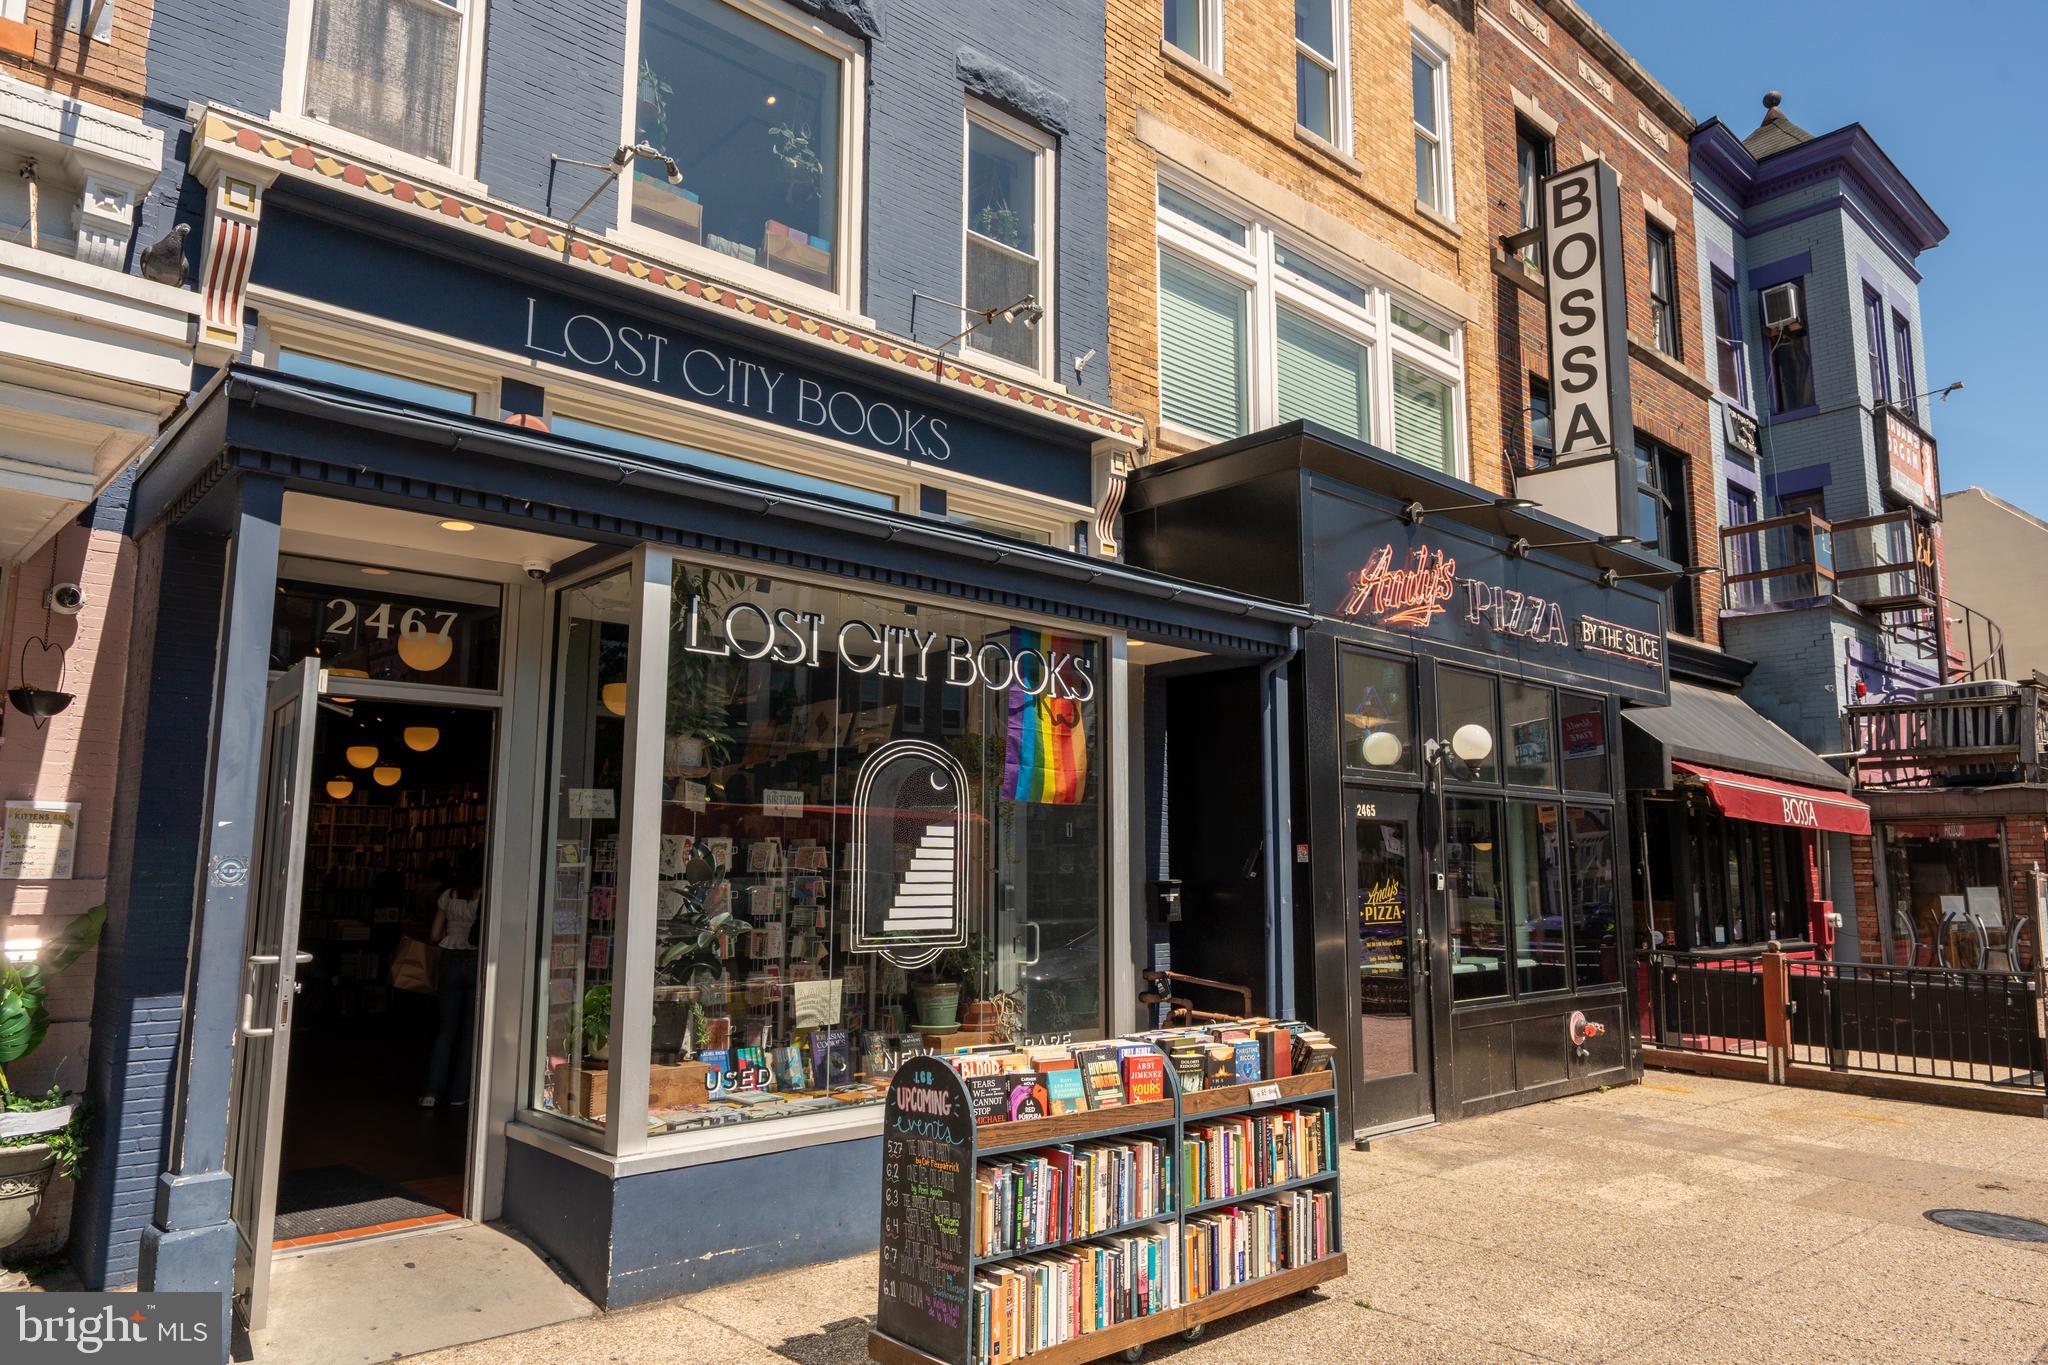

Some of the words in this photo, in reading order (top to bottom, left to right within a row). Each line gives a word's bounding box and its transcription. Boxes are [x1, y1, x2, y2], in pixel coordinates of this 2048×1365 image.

[1551, 175, 1608, 454] BOSSA
[524, 297, 668, 383] LOST
[682, 348, 785, 414] CITY
[796, 377, 951, 461] BOOKS
[1349, 543, 1456, 627] Andy's
[1468, 578, 1569, 646] PIZZA
[1581, 621, 1597, 643] BY
[1598, 626, 1623, 650] THE
[1625, 632, 1659, 660] SLICE
[325, 597, 459, 644] 2467
[683, 593, 825, 668] LOST
[837, 618, 937, 682] CITY
[944, 633, 1096, 702] BOOKS
[766, 794, 801, 806] BIRTHDAY
[1356, 804, 1376, 817] 2465
[1782, 797, 1818, 827] BOSSA
[1368, 878, 1399, 906] Andy's
[1365, 905, 1402, 921] PIZZA
[1235, 1047, 1260, 1056] CHRISTINE
[1239, 1055, 1257, 1063] RICCIO
[961, 1059, 1001, 1079] BLOOD
[1088, 1060, 1118, 1076] HIVEMIND
[1136, 1062, 1155, 1071] ABBY
[704, 1067, 773, 1094] USED
[1130, 1070, 1163, 1080] JIMENEZ
[973, 1080, 996, 1089] TEARS
[1132, 1083, 1161, 1096] YOURS
[896, 1086, 952, 1117] UPCOMING
[973, 1089, 986, 1098] WE
[973, 1096, 1003, 1107] CANNOT
[974, 1107, 992, 1116] STOP
[975, 1114, 1006, 1125] MICHAEL
[892, 1116, 965, 1146] events
